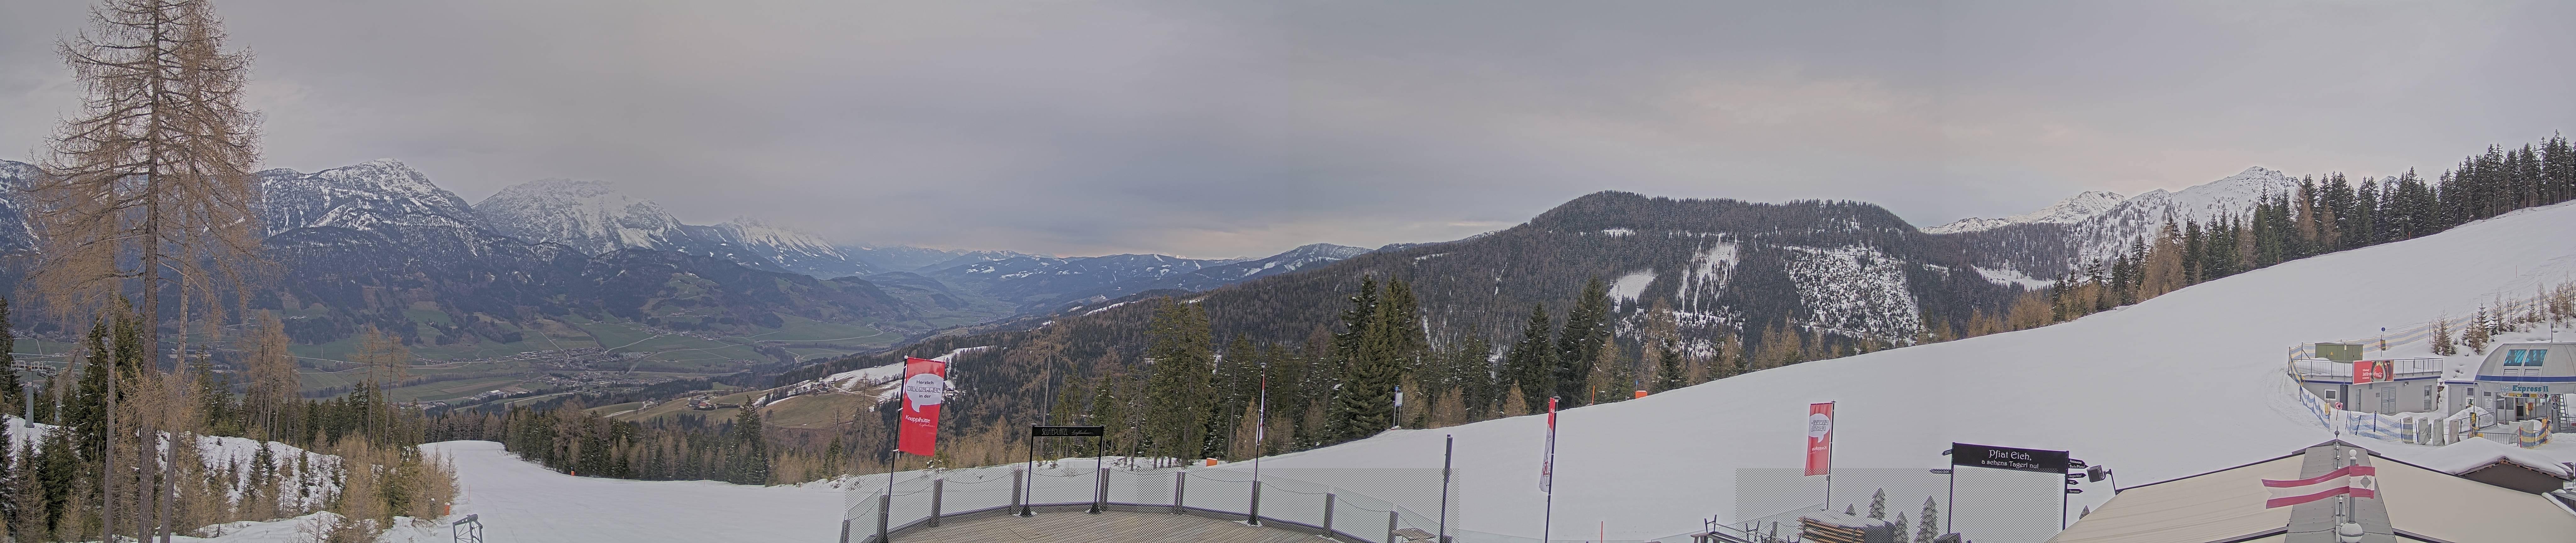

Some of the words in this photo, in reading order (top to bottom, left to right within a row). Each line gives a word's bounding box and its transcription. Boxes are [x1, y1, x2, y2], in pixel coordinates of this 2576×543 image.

[906, 415, 930, 423] Knapplhütte
[1989, 450, 2008, 459] Pfiat
[2011, 452, 2032, 461] Eich,
